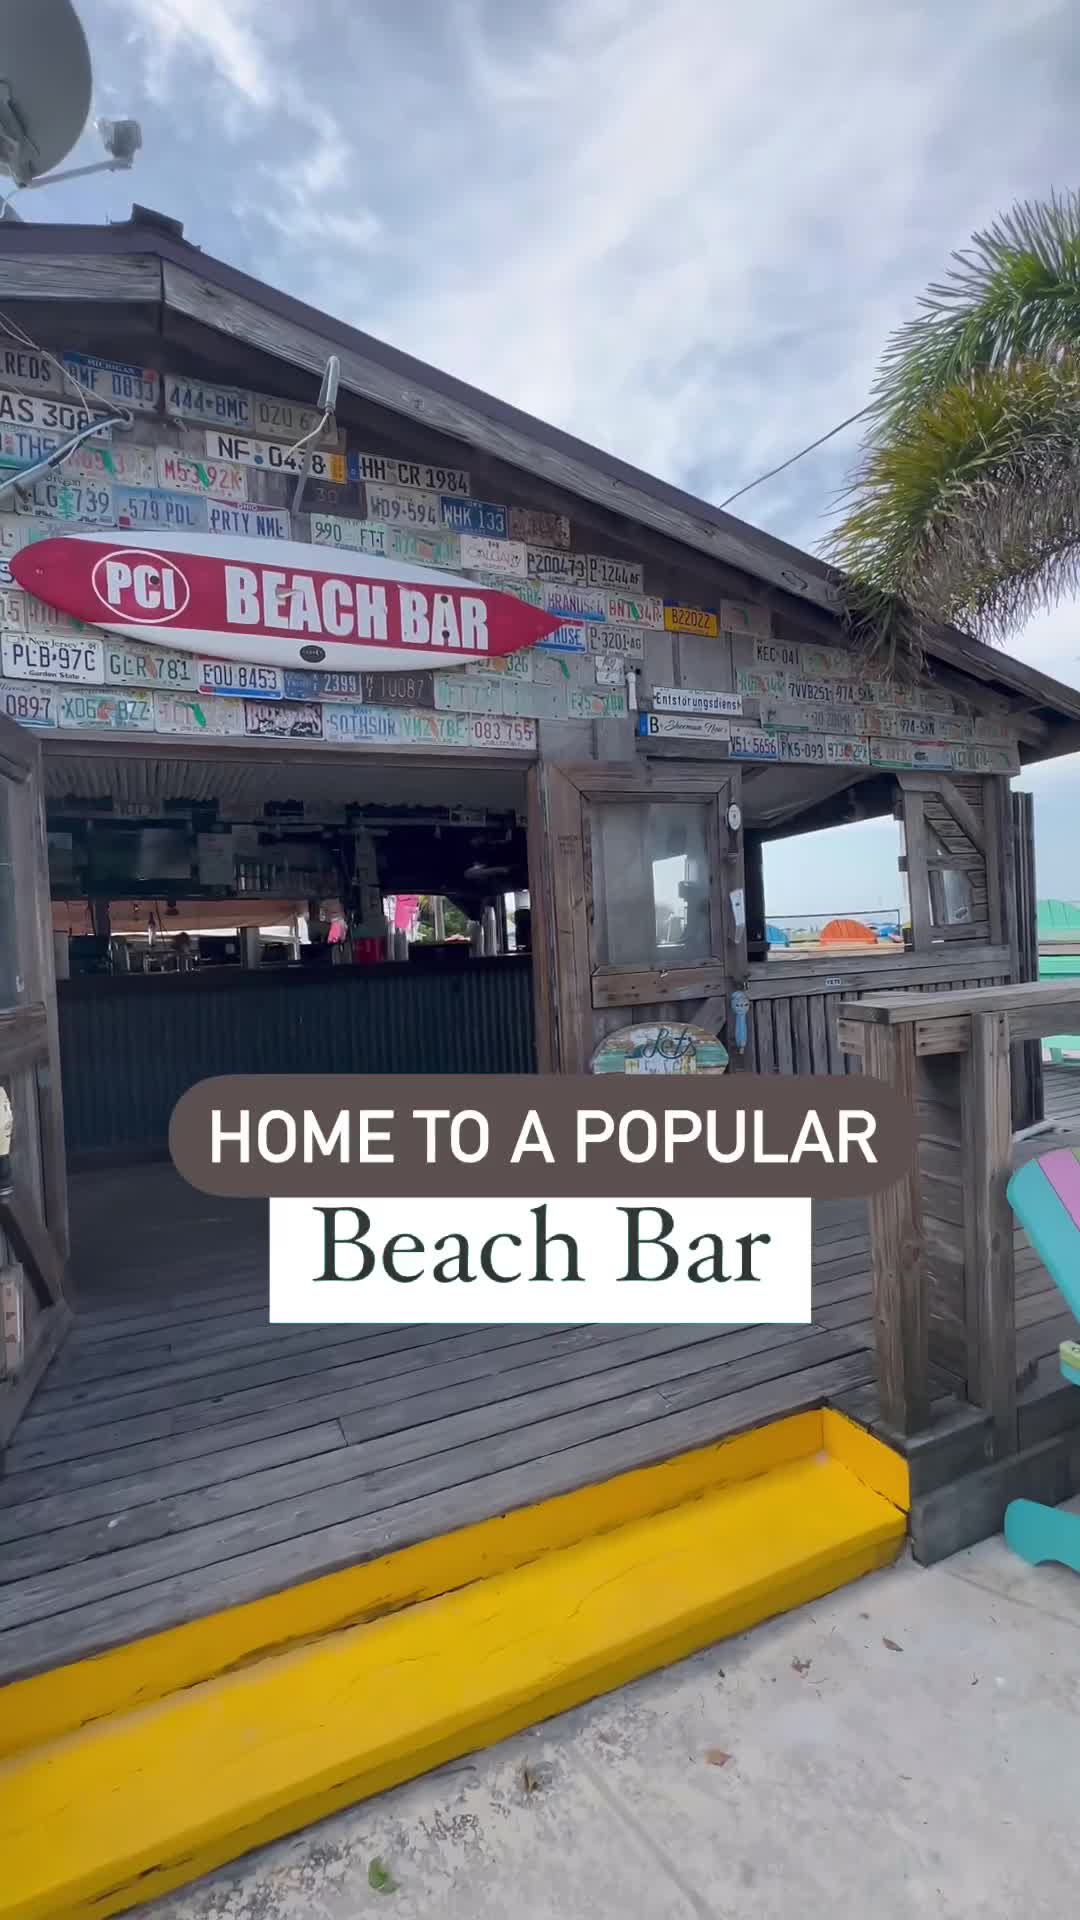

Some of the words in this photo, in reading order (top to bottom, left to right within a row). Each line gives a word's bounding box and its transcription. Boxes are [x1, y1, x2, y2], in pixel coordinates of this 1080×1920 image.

[218, 437, 250, 460] NF
[362, 457, 386, 480] HH
[398, 463, 421, 487] CR
[426, 468, 469, 493] 1984
[72, 488, 110, 513] 739
[210, 509, 249, 534] PRTY
[315, 522, 343, 543] 990
[479, 510, 505, 533] 133
[602, 564, 628, 585] 1244
[224, 565, 387, 640] BEACH
[398, 588, 489, 650] BAR
[30, 638, 52, 646] New
[53, 640, 78, 650] Jersey
[602, 631, 629, 651] 3201
[156, 658, 191, 681] 781
[239, 667, 277, 690] 8453
[324, 674, 357, 693] 2399
[649, 717, 660, 734] B
